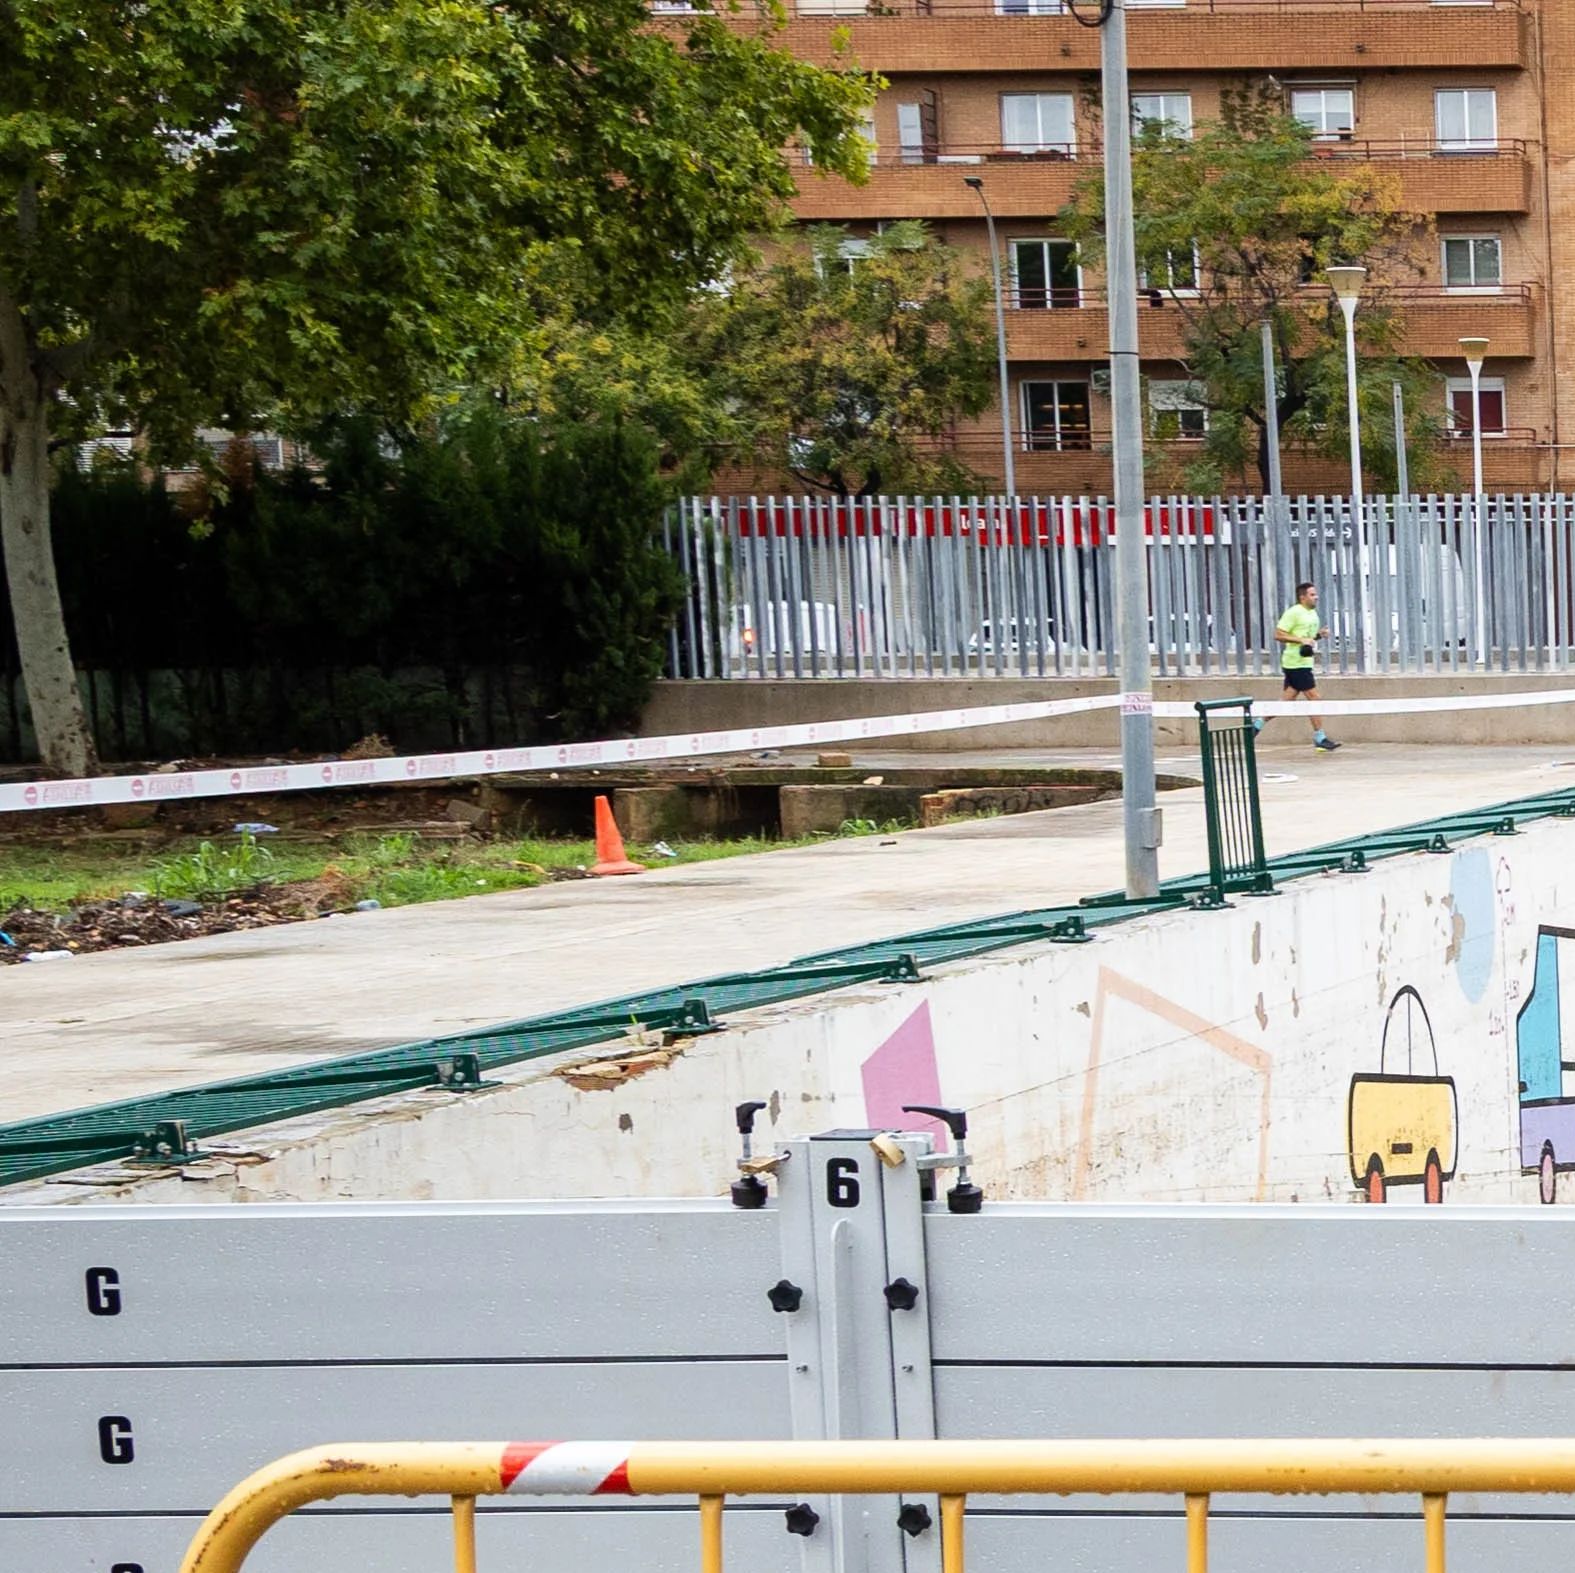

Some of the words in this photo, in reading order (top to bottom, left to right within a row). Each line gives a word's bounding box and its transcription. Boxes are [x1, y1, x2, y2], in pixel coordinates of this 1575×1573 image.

[826, 1157, 861, 1208] 6
[85, 1266, 122, 1317] G
[98, 1415, 135, 1465] G
